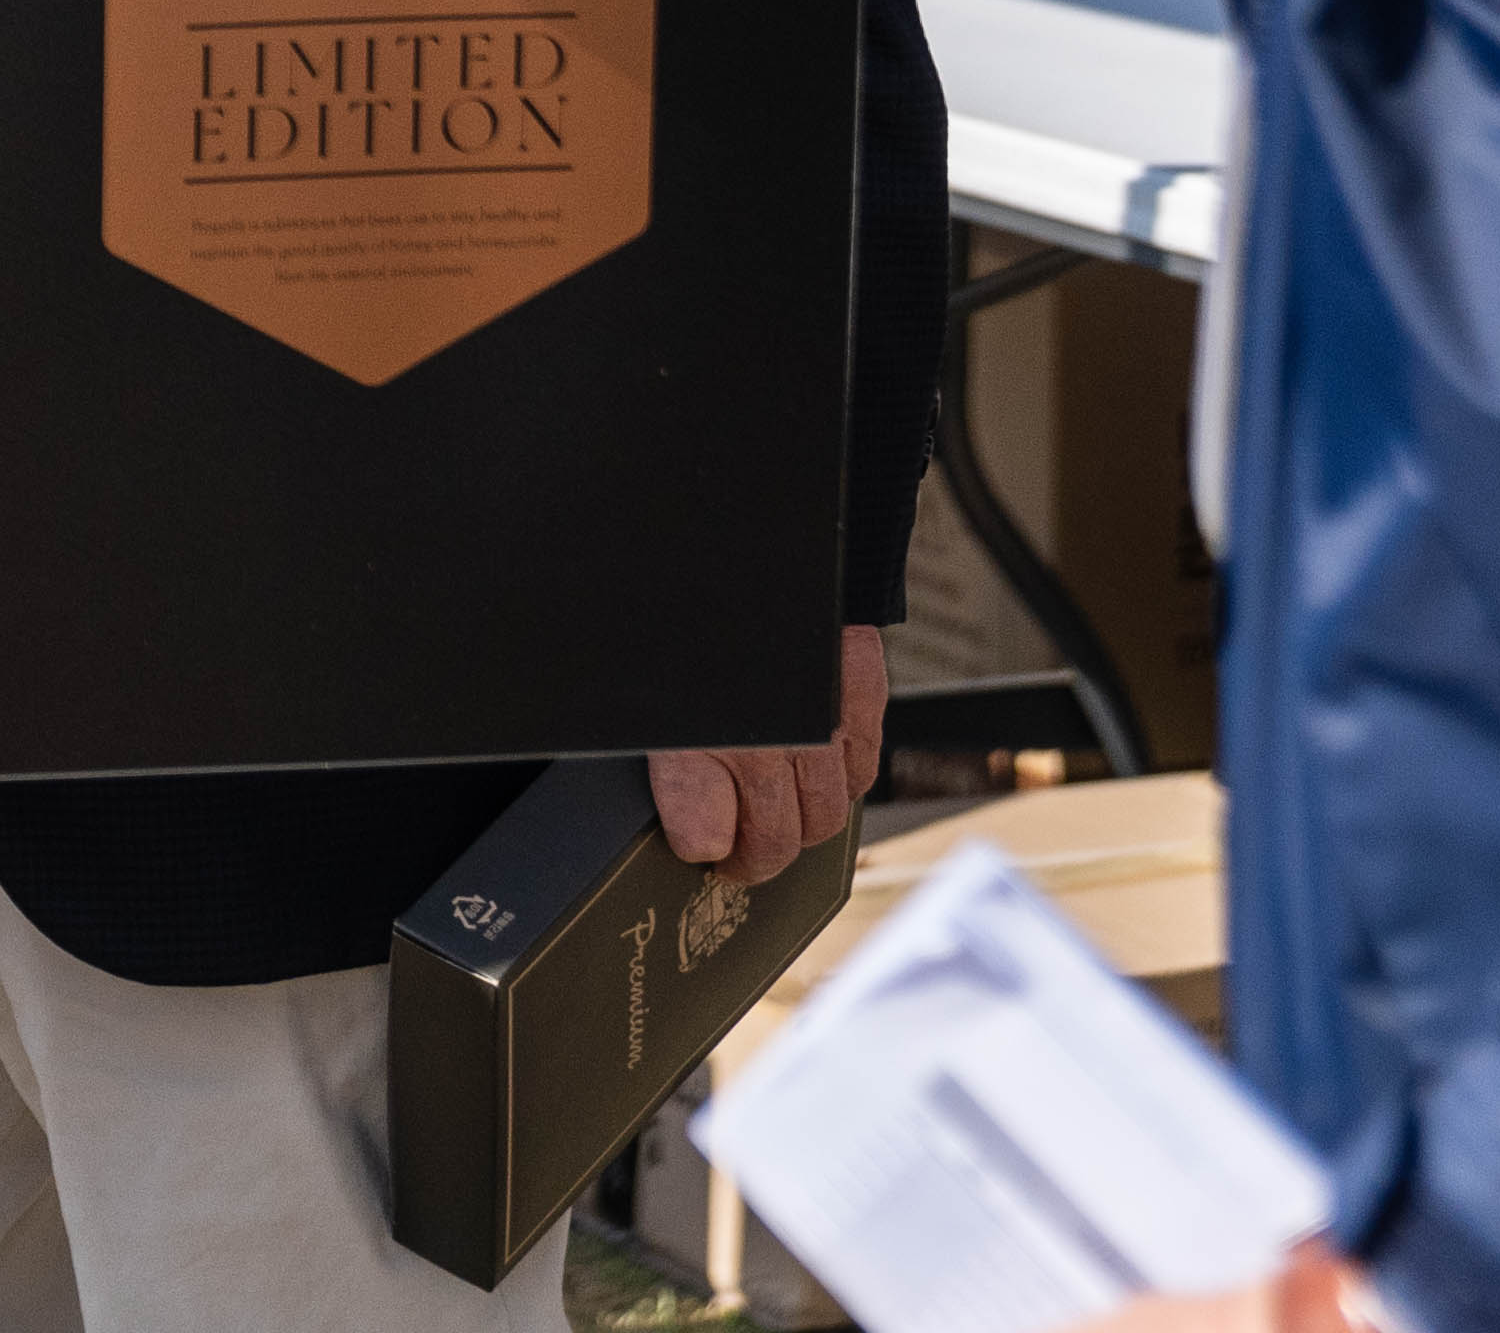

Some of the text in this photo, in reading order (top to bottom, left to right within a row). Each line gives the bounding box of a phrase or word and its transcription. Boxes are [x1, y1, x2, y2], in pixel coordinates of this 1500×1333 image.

[200, 31, 568, 101] LIMITED
[191, 93, 570, 165] EDITION
[619, 906, 657, 1070] Premium
